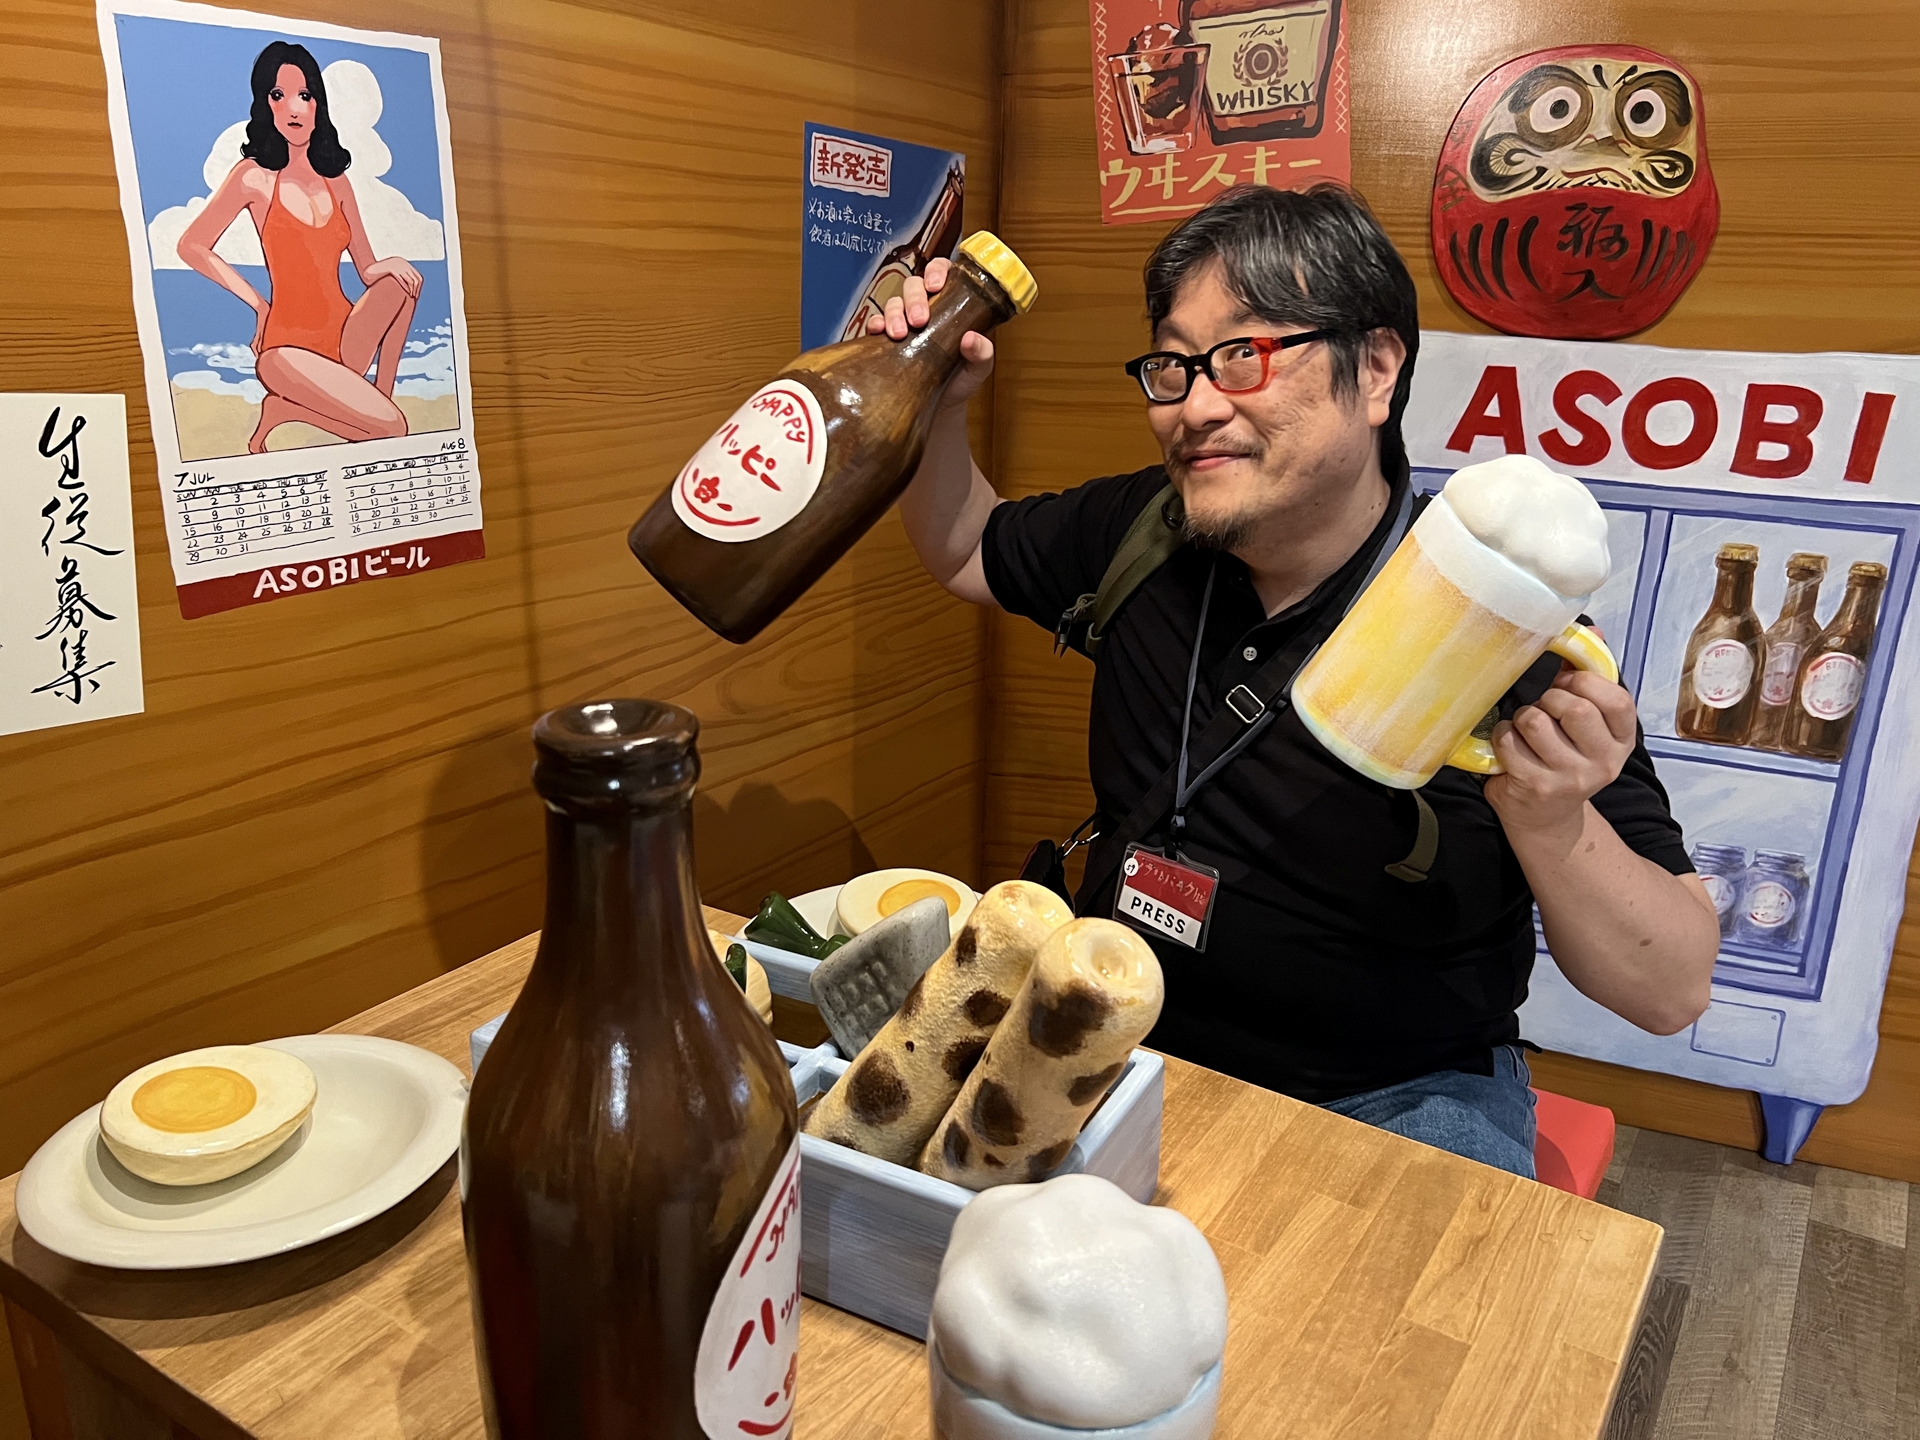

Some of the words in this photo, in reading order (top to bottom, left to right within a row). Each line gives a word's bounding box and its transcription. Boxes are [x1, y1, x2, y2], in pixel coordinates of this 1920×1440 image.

[1217, 80, 1315, 110] WHISKY
[817, 142, 887, 186] 新発売
[1445, 365, 1897, 484] ASOBI
[441, 441, 456, 451] AUG
[458, 438, 465, 449] 8
[715, 423, 782, 491] ハッピー
[174, 472, 189, 487] 7
[190, 472, 215, 485] JUL
[277, 479, 291, 487] THU
[210, 497, 218, 505] 2
[235, 494, 240, 503] 3
[257, 491, 266, 499] 4
[281, 489, 288, 498] 5
[300, 485, 305, 494] 6
[184, 515, 191, 523] 8
[212, 510, 218, 519] 9
[235, 507, 244, 515] 10
[259, 504, 266, 512] 11
[320, 494, 331, 503] 14
[351, 513, 359, 522] 19
[185, 528, 196, 536] 15
[213, 523, 222, 531] 16
[236, 520, 245, 528] 17
[283, 512, 291, 520] 19
[188, 539, 199, 548] 22
[214, 535, 224, 544] 23
[238, 532, 248, 540] 24
[262, 528, 271, 536] 25
[284, 524, 293, 532] 26
[303, 521, 312, 530] 27
[353, 525, 361, 533] 26
[240, 543, 249, 552] 31
[1131, 896, 1185, 934] PRESS
